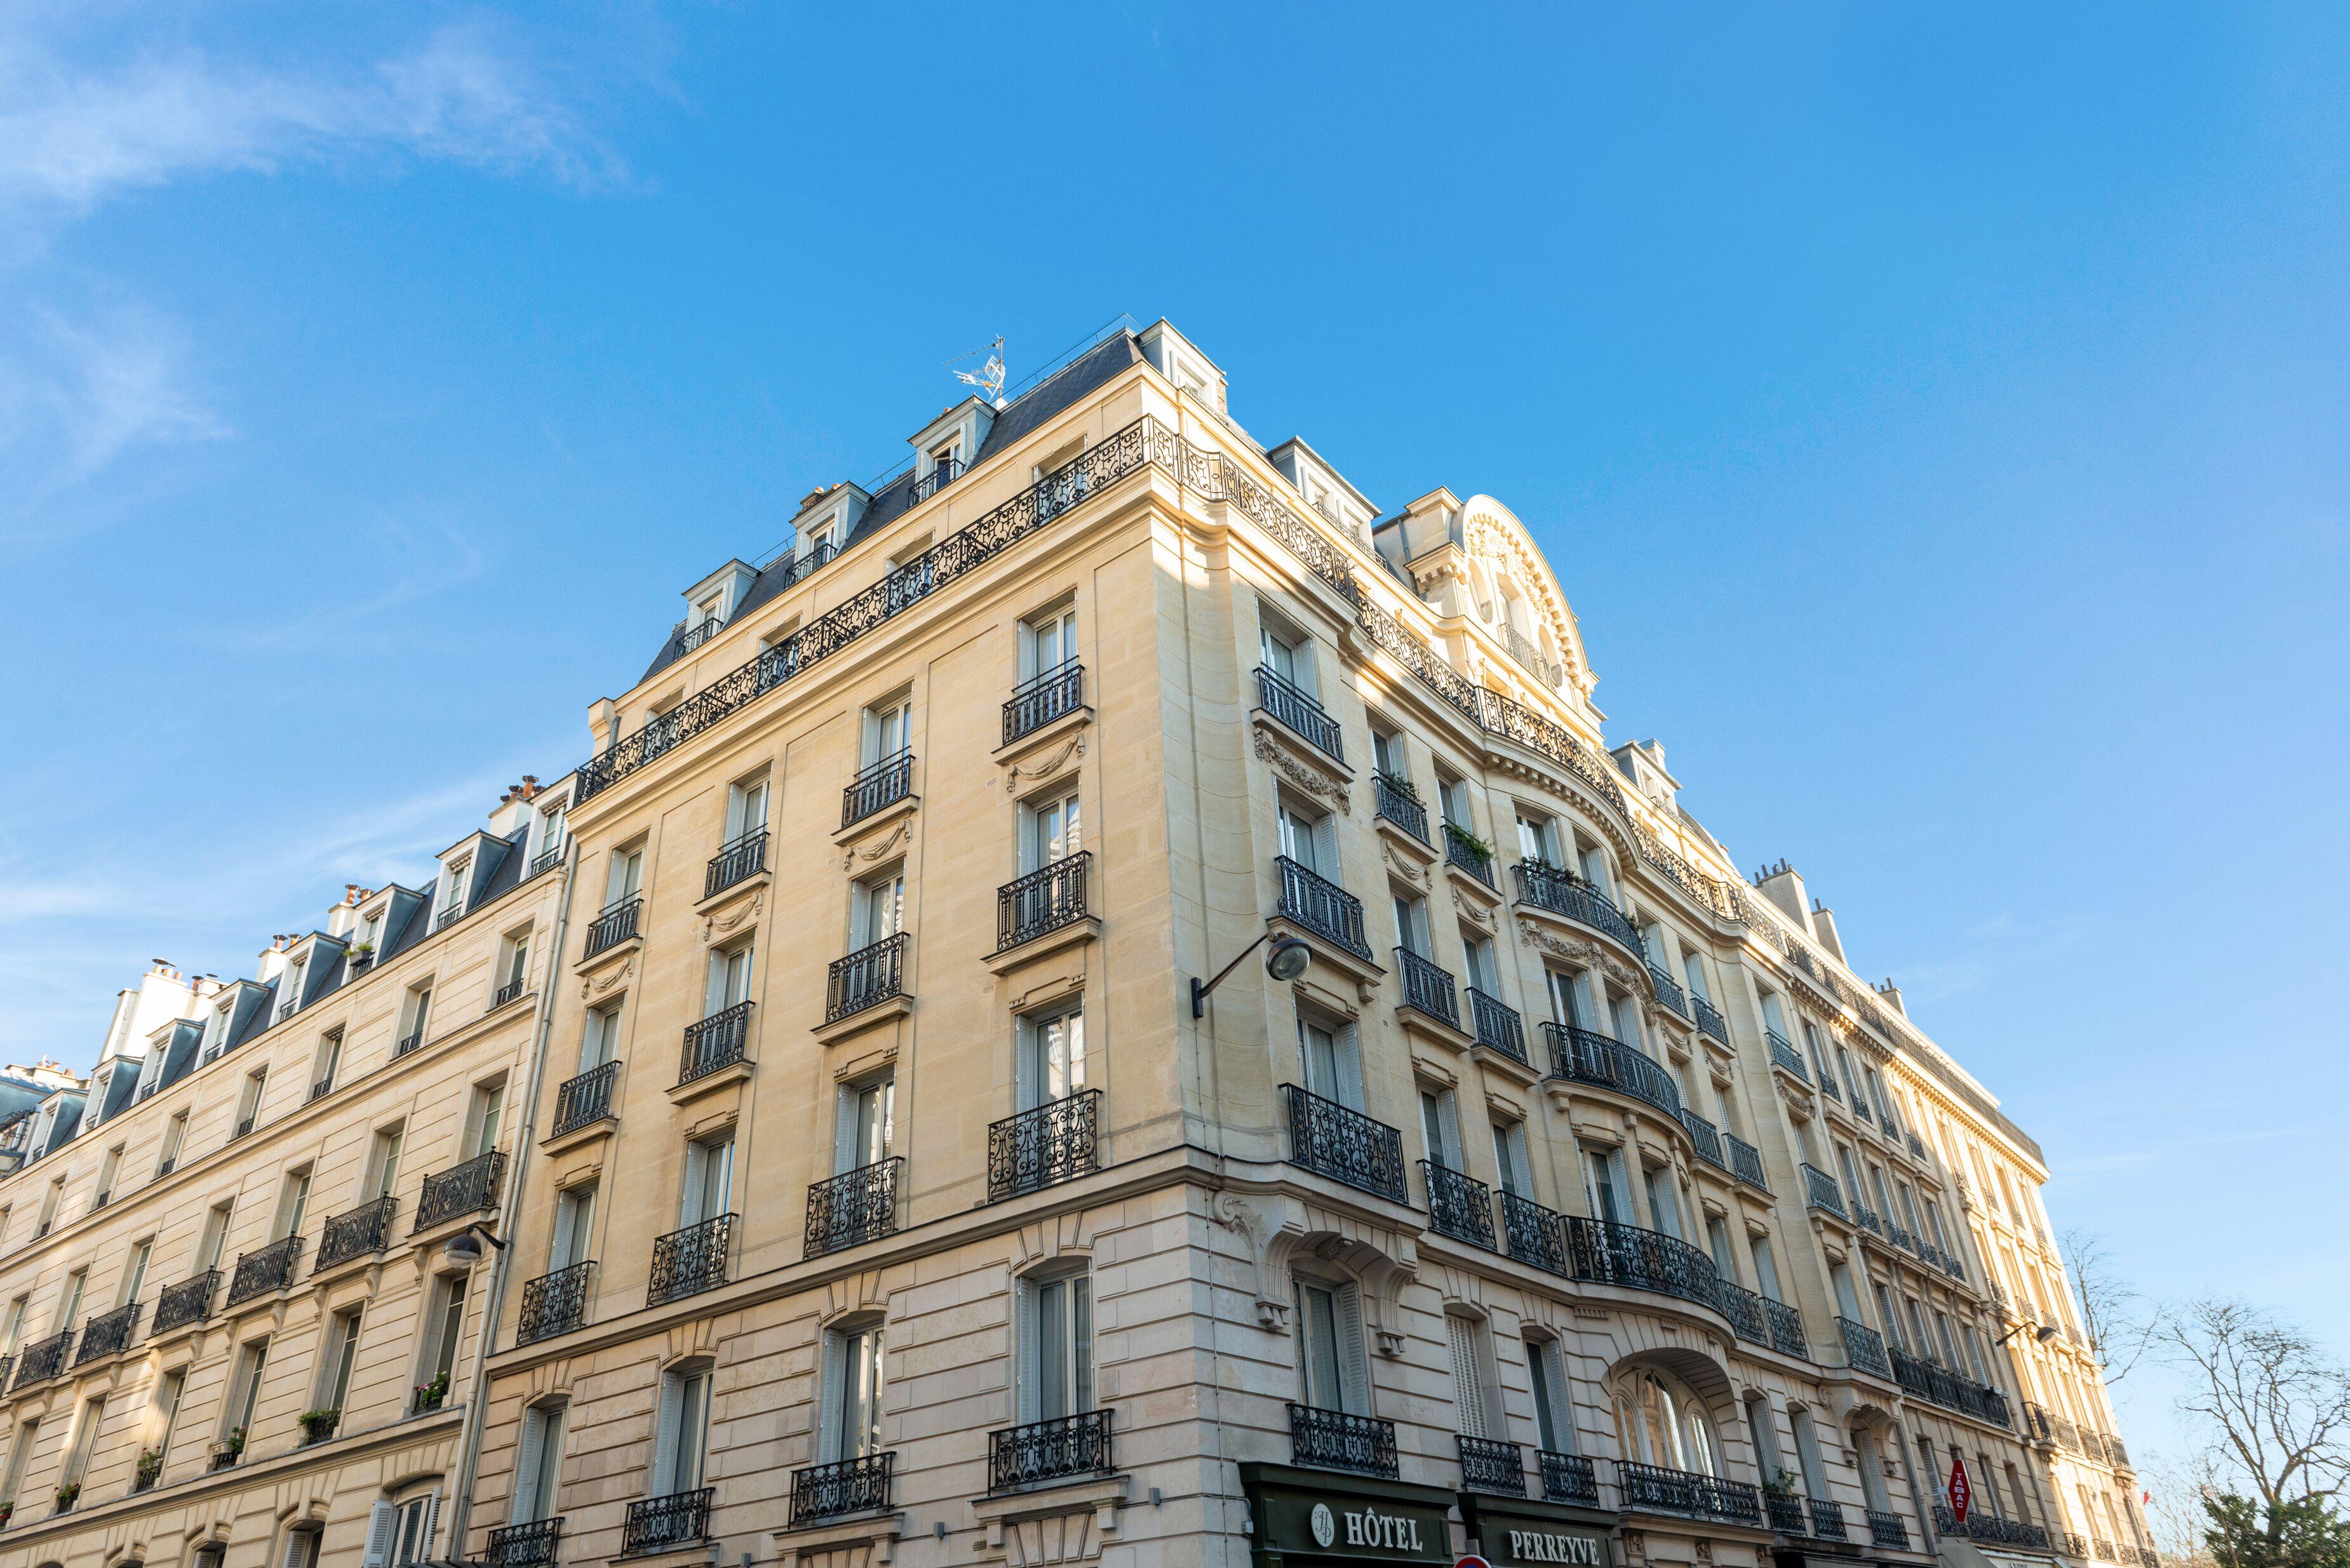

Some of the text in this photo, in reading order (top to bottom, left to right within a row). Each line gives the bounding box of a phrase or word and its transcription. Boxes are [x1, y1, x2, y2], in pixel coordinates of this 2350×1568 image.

[1954, 1473, 1965, 1508] TABAC
[1344, 1506, 1423, 1552] HÔTEL
[1509, 1530, 1600, 1567] PERREYVE
